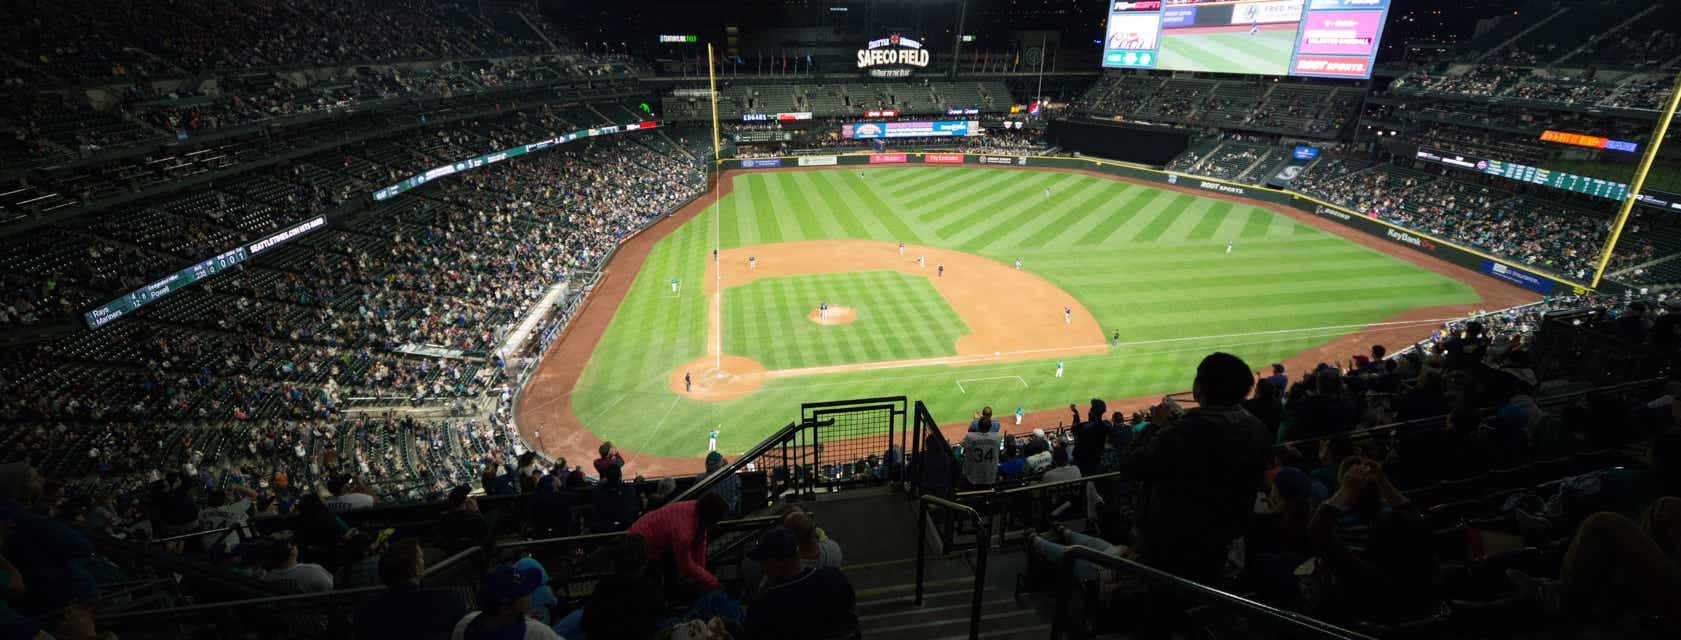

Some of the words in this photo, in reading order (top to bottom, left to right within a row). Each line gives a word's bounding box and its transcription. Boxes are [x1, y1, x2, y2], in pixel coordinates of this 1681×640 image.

[857, 49, 897, 68] SAFECO
[899, 49, 929, 67] FIELD
[1297, 59, 1328, 70] ROOT
[1200, 181, 1220, 190] ROOT
[1387, 228, 1421, 247] KeyBank
[92, 306, 109, 319] Rays
[95, 310, 123, 327] Mariners
[973, 448, 993, 463] 34
